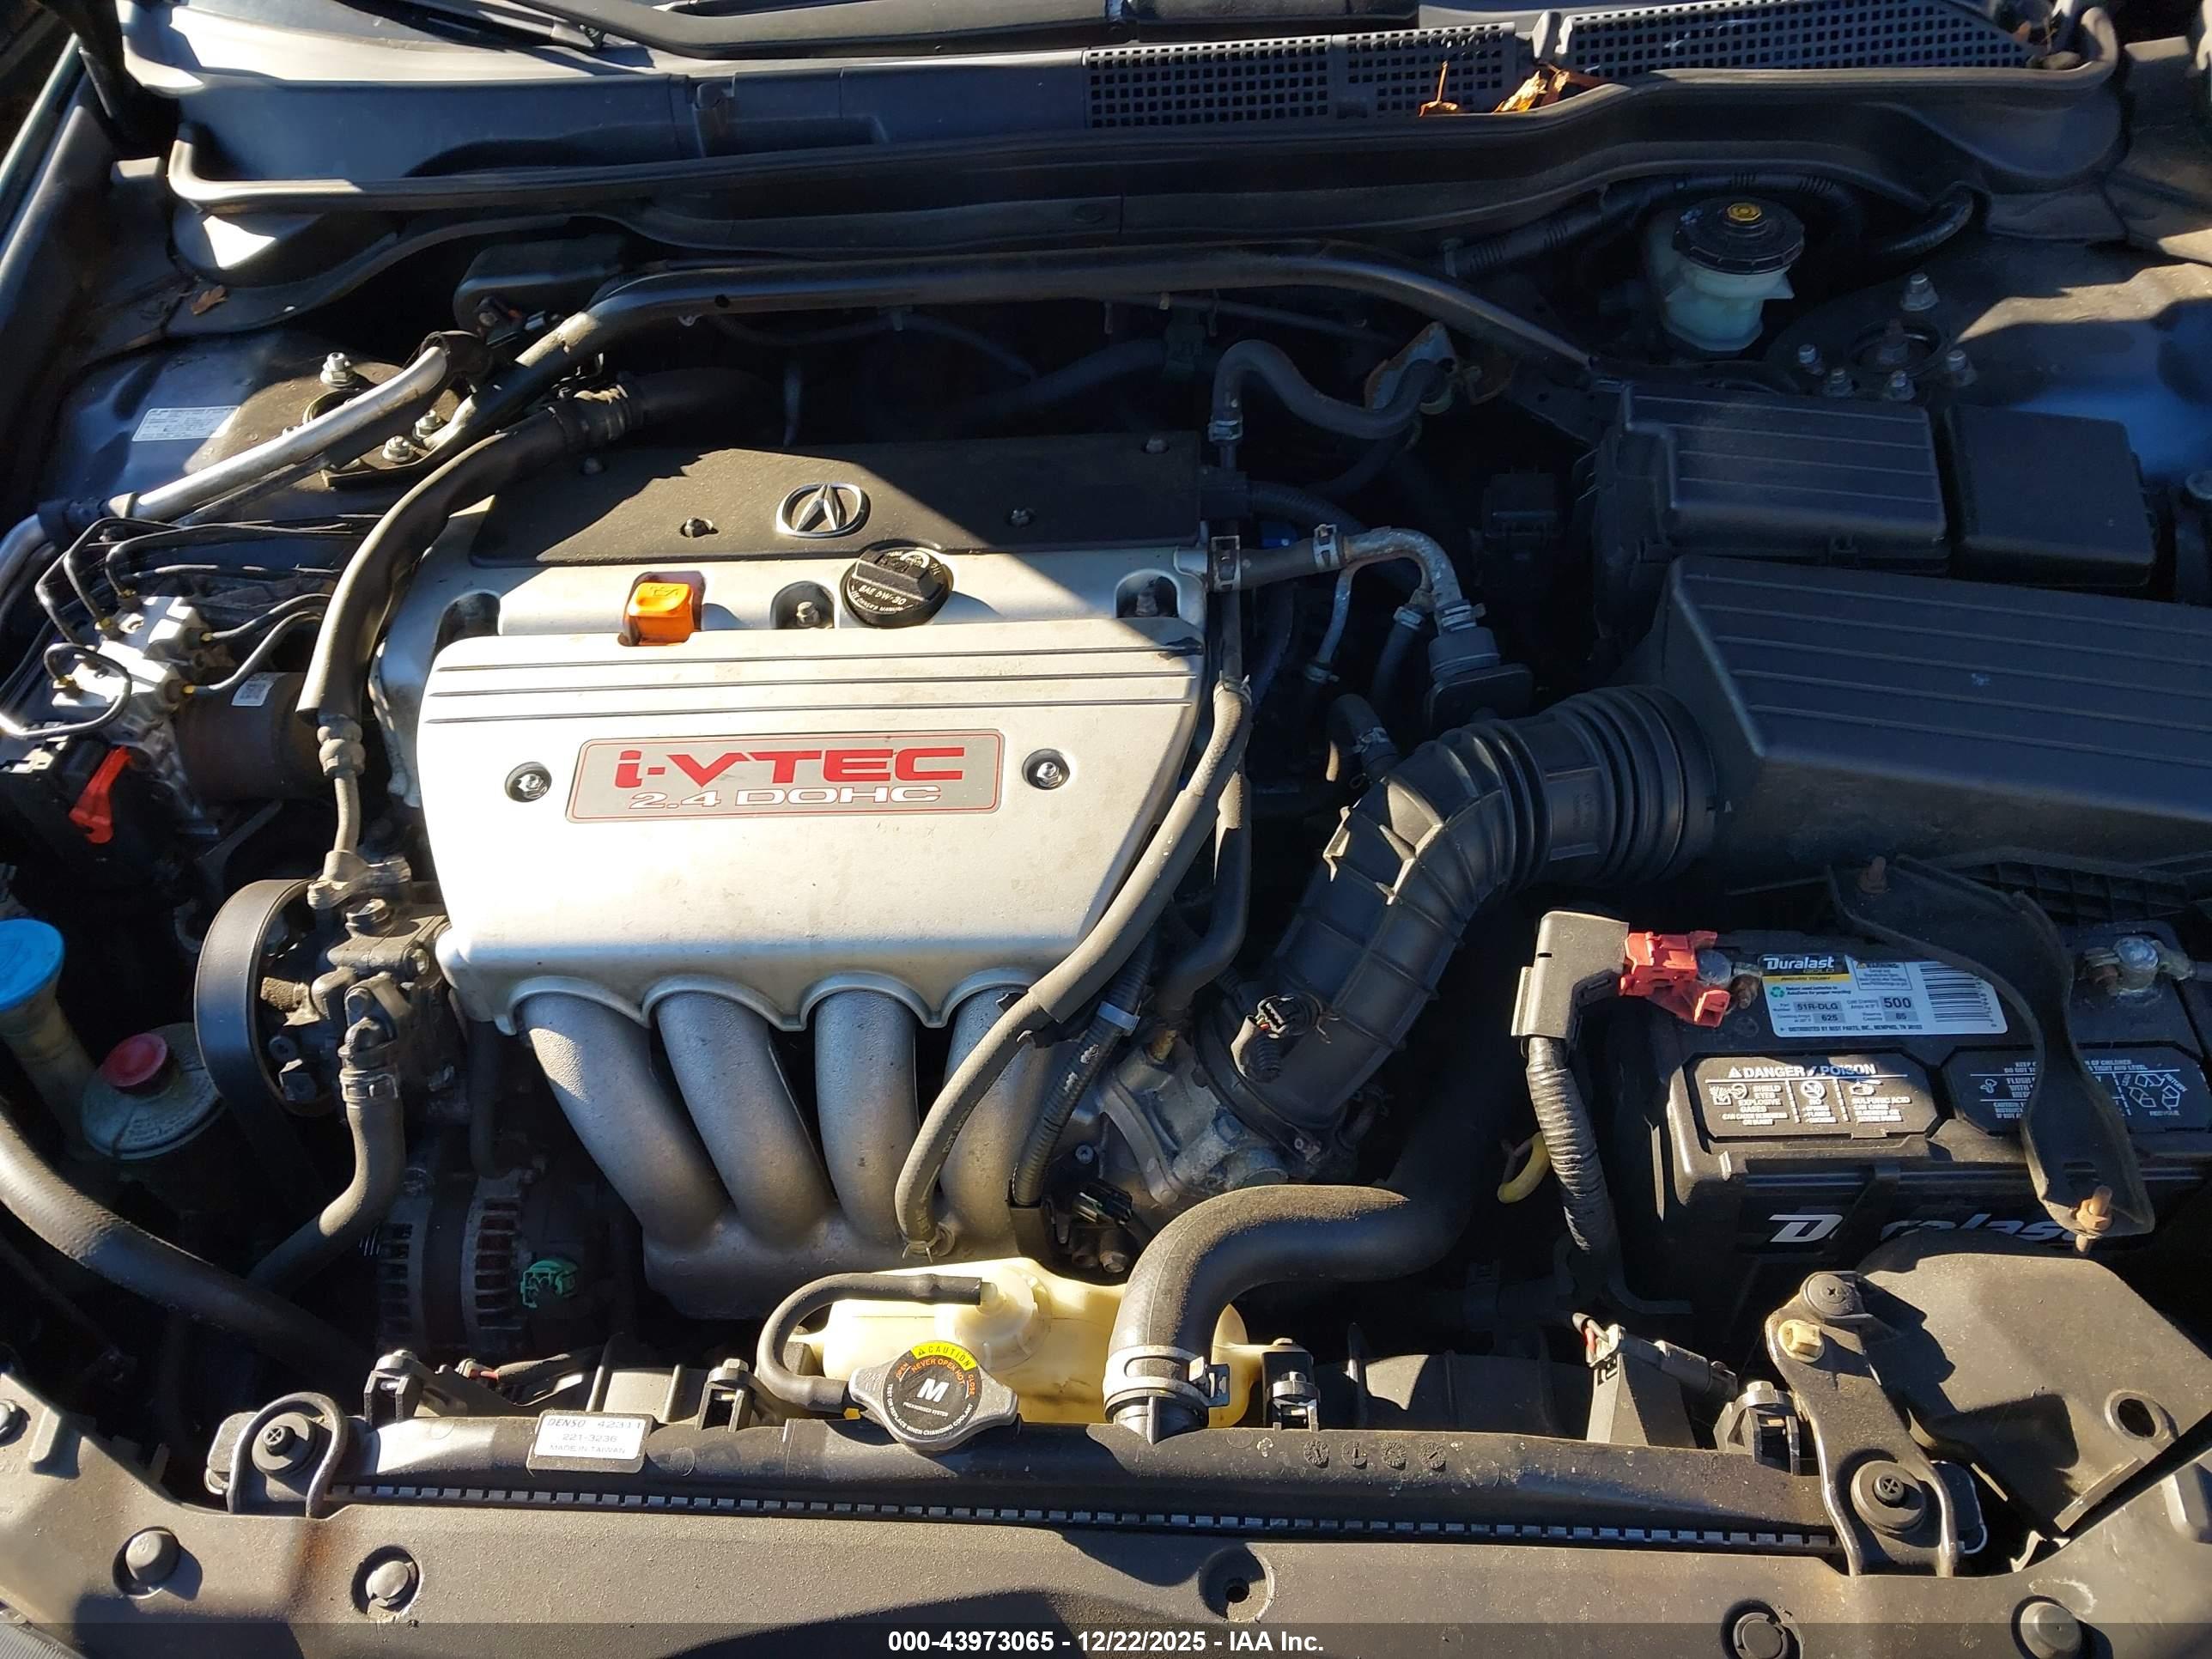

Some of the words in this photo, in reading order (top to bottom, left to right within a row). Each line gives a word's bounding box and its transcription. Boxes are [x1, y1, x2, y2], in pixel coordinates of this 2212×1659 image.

[615, 747, 964, 788] i-VTEC
[629, 789, 721, 810] 2.4
[735, 785, 941, 806] DOHC
[1763, 956, 1834, 969] Duralast
[1797, 1002, 1838, 1011] 51R-DLG
[1883, 997, 1911, 1008] 500
[1742, 1066, 1806, 1079] DANGER
[1820, 1064, 1876, 1076] POISON
[927, 1346, 971, 1367] CAUTION
[896, 1362, 908, 1378] OPEN
[911, 1358, 936, 1374] NEVER
[938, 1358, 957, 1372] OPEN
[955, 1369, 966, 1385] HOT
[916, 1377, 950, 1403] M
[547, 1418, 586, 1428] DENSO
[890, 1407, 907, 1428] REPLACE
[906, 1425, 923, 1435] WHEN
[923, 1424, 954, 1436] CHANGING
[953, 1402, 973, 1426] COOLANT
[562, 1433, 618, 1443] 221-3236
